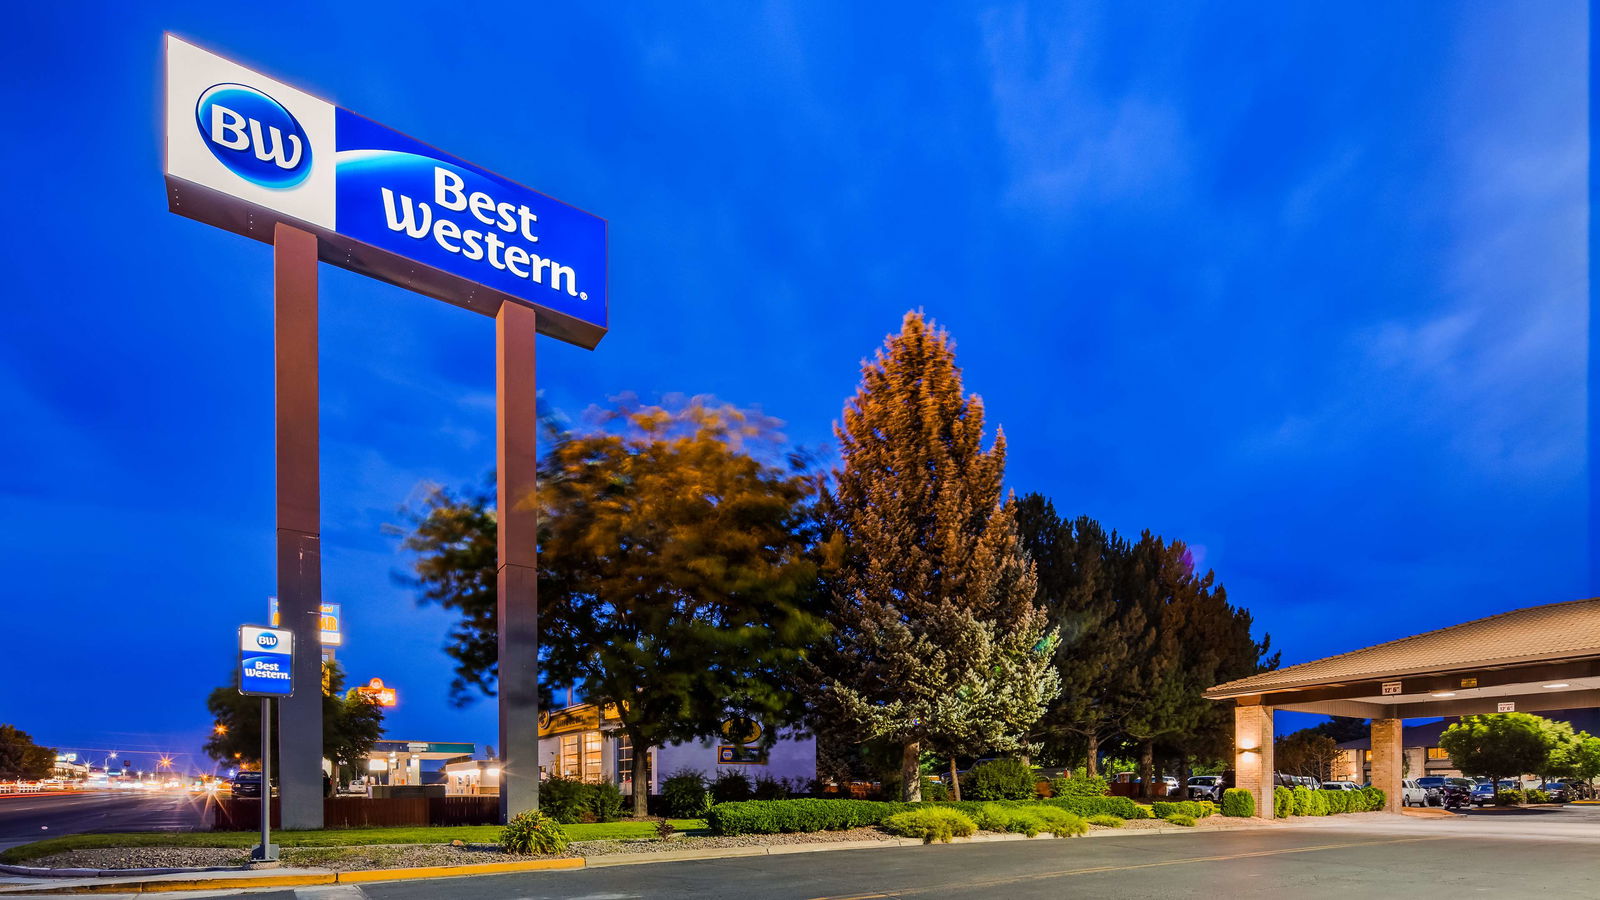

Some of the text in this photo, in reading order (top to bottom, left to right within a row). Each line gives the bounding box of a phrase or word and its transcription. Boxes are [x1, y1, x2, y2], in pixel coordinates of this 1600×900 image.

[211, 103, 303, 170] BW
[434, 166, 539, 243] Best
[258, 636, 276, 646] BW
[255, 661, 279, 671] Best
